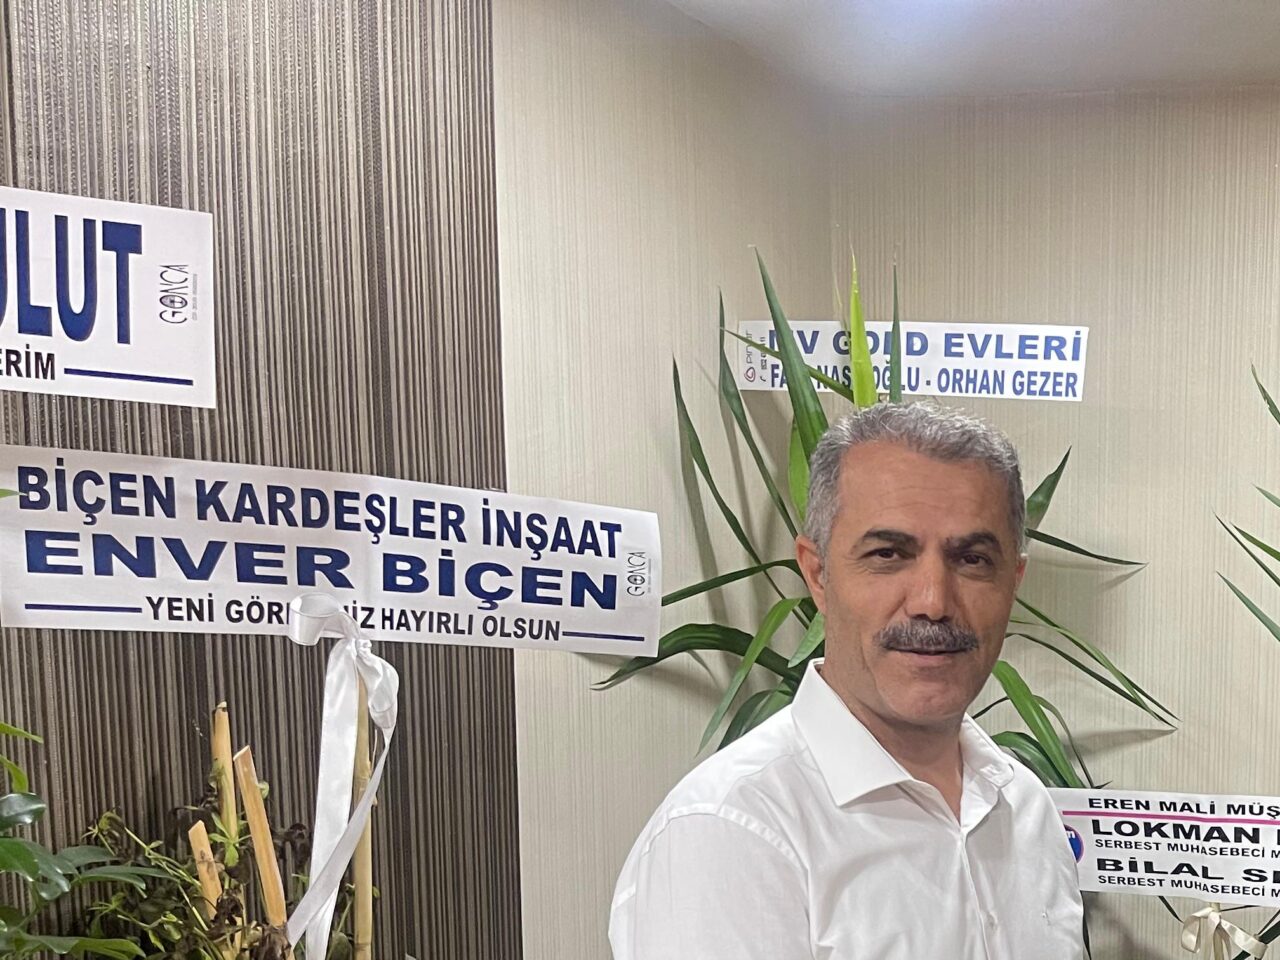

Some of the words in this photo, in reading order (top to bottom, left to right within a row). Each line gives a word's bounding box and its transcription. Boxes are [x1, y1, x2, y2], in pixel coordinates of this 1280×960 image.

[0, 207, 142, 345] LUT
[159, 264, 190, 324] GONCA
[944, 330, 1082, 362] EVLERİ
[937, 368, 1005, 395] ORHAN
[1012, 370, 1078, 397] GEZER
[18, 457, 177, 526] BİÇEN
[195, 478, 467, 545] KARDEŞLER
[482, 498, 622, 561] İNŞAAT
[25, 530, 355, 590] ENVER
[383, 549, 618, 611] BİÇEN
[627, 551, 646, 597] GONCA
[146, 592, 214, 623] YENİ
[382, 607, 474, 636] HAYIRLI
[482, 615, 561, 641] OLSUN
[1088, 798, 1150, 811] EREN
[1159, 801, 1216, 815] MALİ
[1092, 819, 1260, 844] LOKMAN
[1095, 839, 1162, 851] SERBEST
[1167, 843, 1266, 858] MUHASEBECİ
[1097, 857, 1225, 880] BİLAL
[1098, 875, 1166, 887] SERBEST
[1171, 880, 1266, 897] MUHASEBECİ
